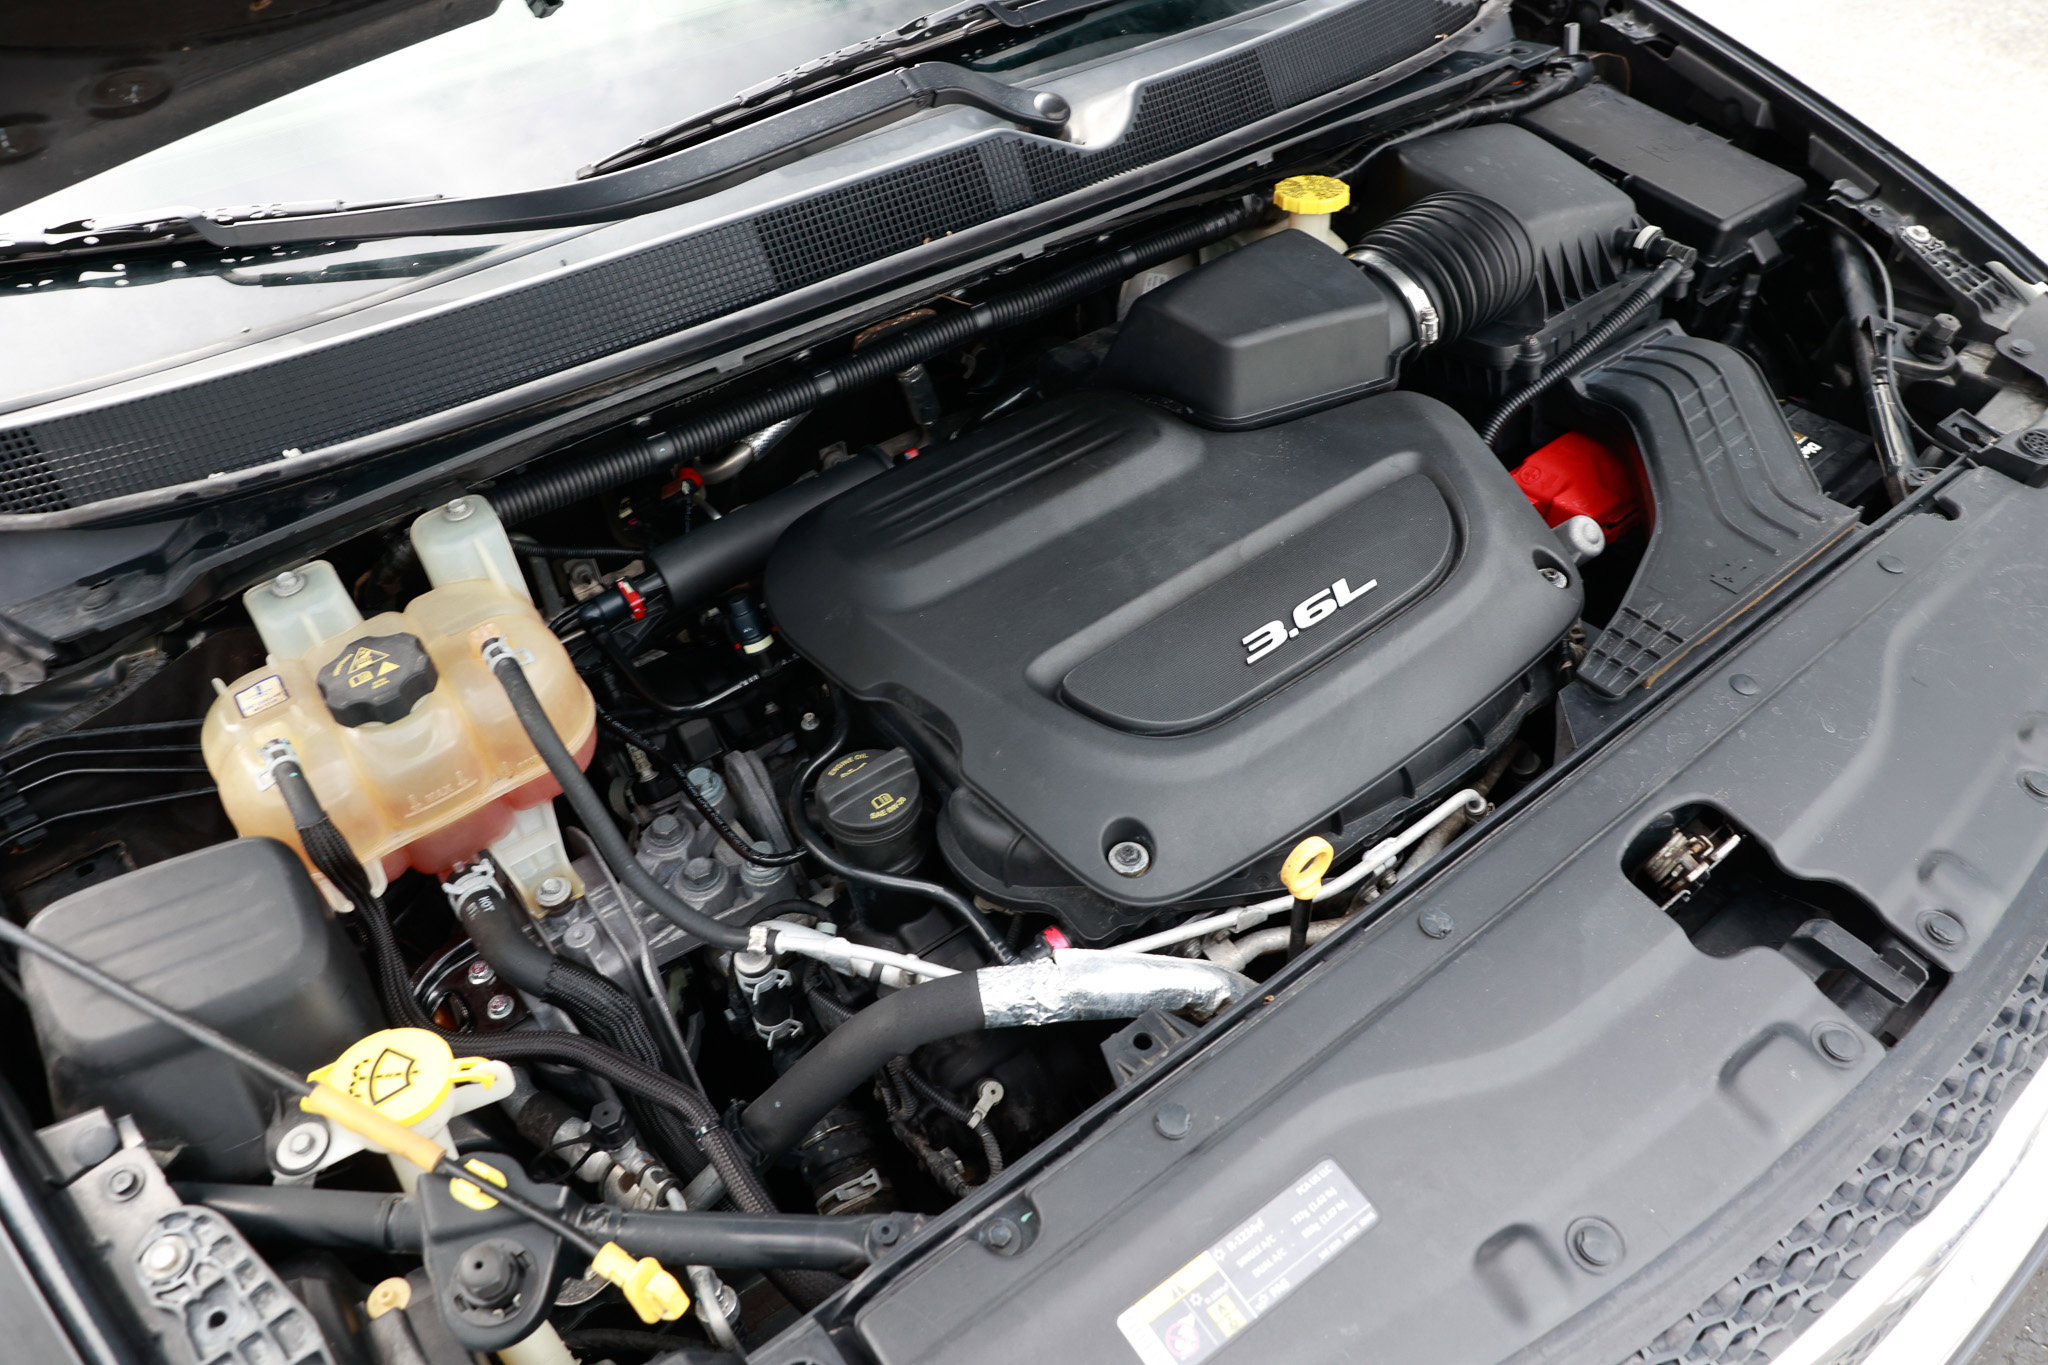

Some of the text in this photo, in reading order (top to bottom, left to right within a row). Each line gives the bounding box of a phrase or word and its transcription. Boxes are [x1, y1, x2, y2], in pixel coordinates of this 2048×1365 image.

[1241, 577, 1378, 665] 3.6L
[828, 753, 869, 776] ENGINE OIL
[869, 809, 888, 819] SAE
[478, 895, 496, 912] HOT
[1295, 1165, 1333, 1196] FCA US LLC
[1225, 1216, 1266, 1252] R-1234yf
[1260, 1234, 1277, 1250] A/C
[1252, 1261, 1274, 1279] DUAL
[1271, 1247, 1288, 1263] A/C
